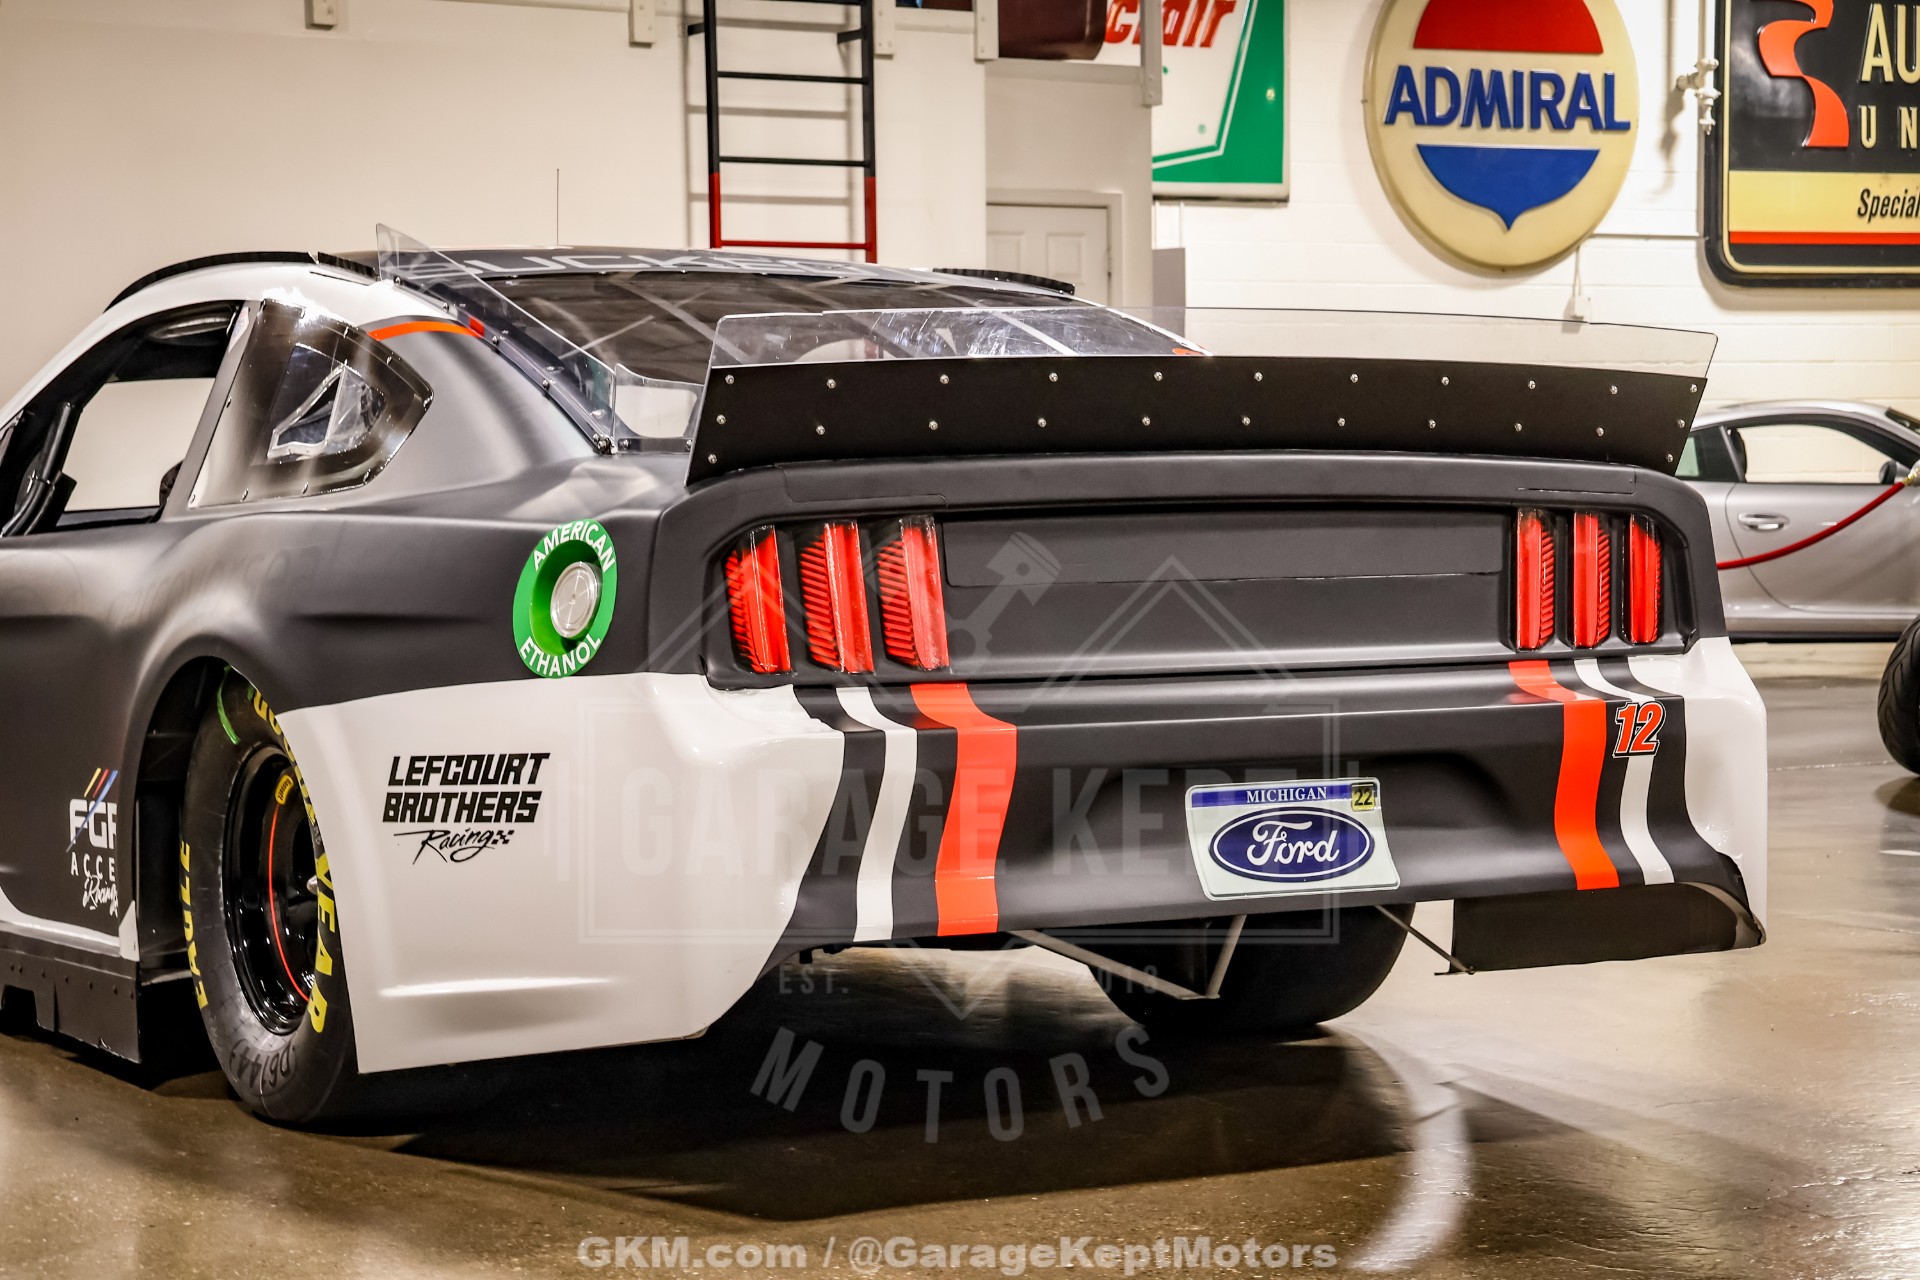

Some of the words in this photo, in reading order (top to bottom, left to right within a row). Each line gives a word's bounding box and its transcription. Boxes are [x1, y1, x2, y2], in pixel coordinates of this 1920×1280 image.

[1103, 0, 1237, 48] cair
[1384, 65, 1631, 131] ADMIRAL
[533, 521, 616, 573] AMERICAN
[519, 634, 602, 677] ETHANOL
[1612, 700, 1667, 758] 12
[388, 752, 551, 787] LEFCOURT
[382, 790, 543, 823] BROTHERS
[1246, 786, 1327, 804] MICHIGAN
[1353, 788, 1374, 807] 22
[394, 828, 496, 865] Racing
[1246, 820, 1340, 866] Ford
